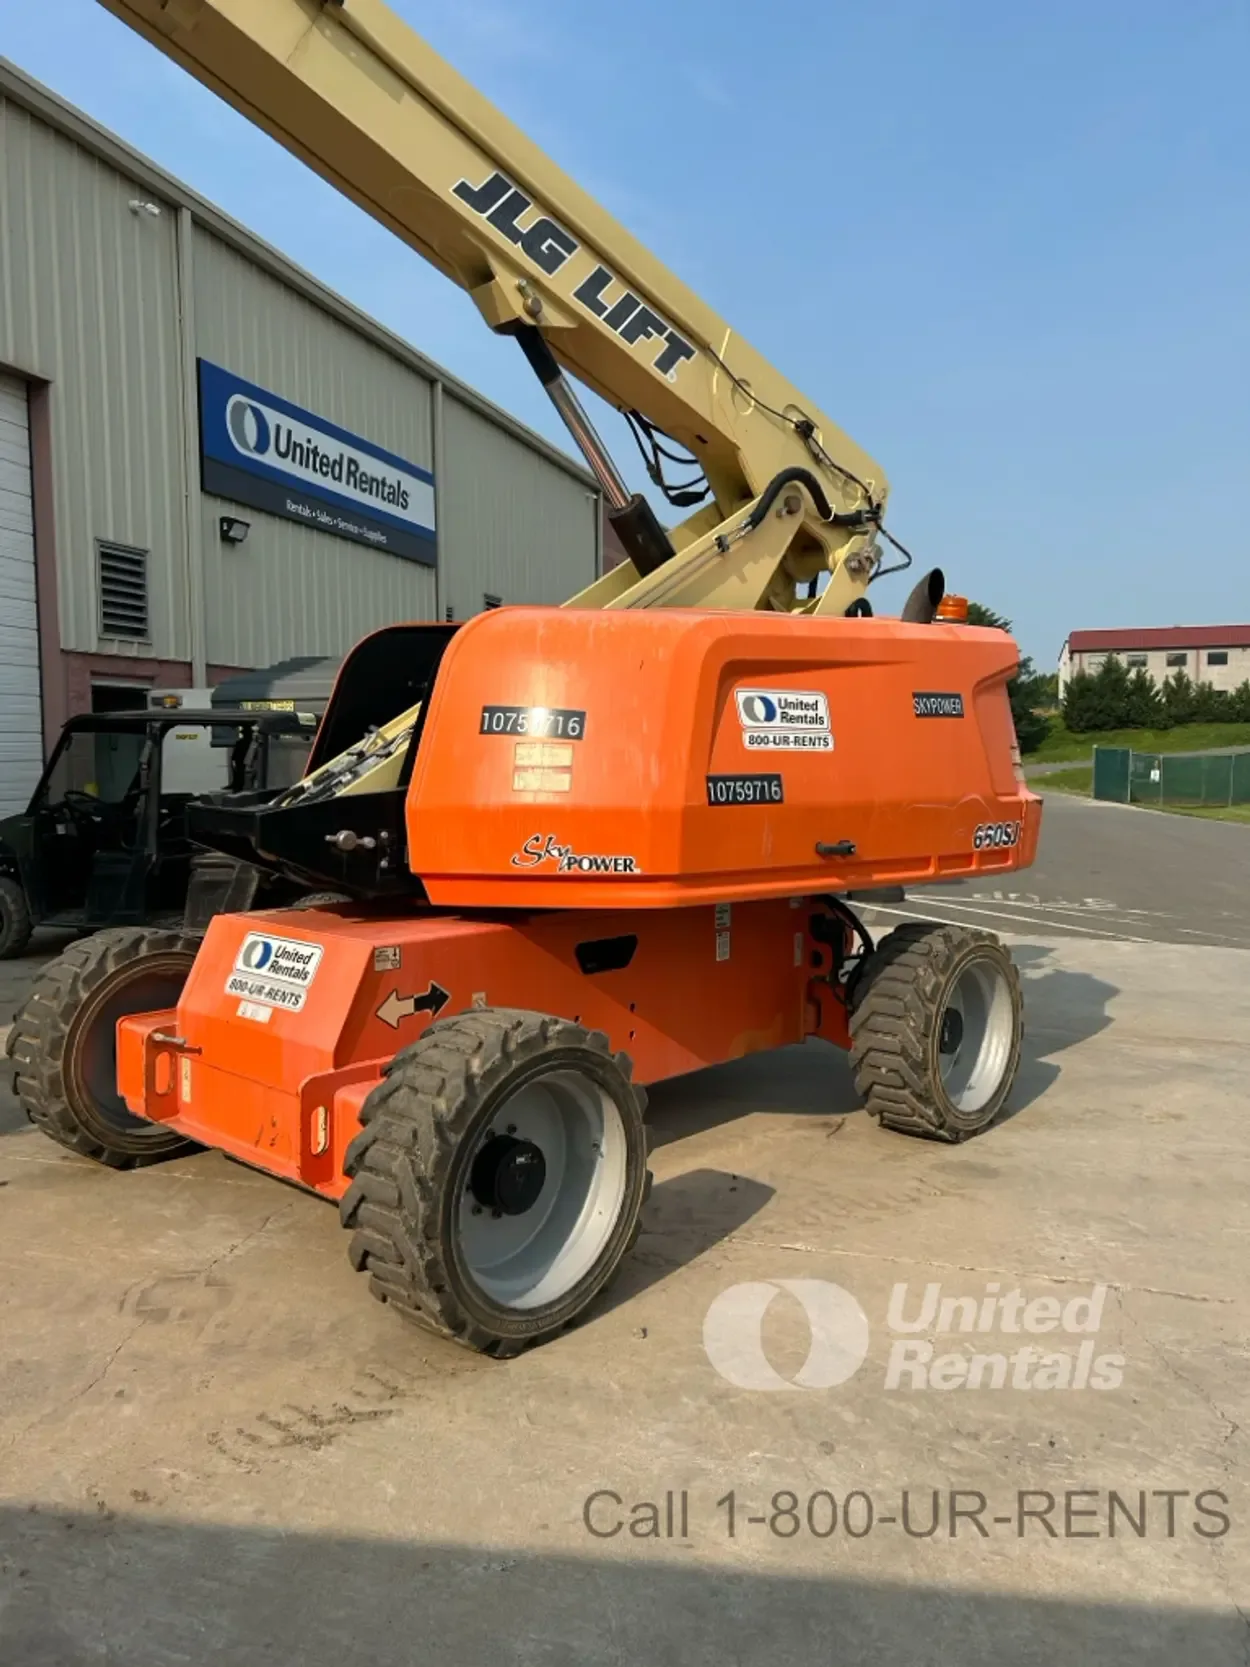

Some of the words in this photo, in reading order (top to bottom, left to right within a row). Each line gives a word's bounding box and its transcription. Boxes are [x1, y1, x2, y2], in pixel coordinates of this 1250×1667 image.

[450, 171, 580, 277] JLG
[573, 264, 697, 376] LIFT
[274, 424, 344, 482] United
[346, 457, 410, 511] Rentals
[777, 698, 819, 712] United
[912, 697, 962, 715] SKYPOWER
[482, 712, 581, 737] 1075716
[780, 711, 825, 726] Rentals
[748, 734, 830, 748] 800-UR-RENTS
[707, 780, 782, 802] 10759716
[273, 945, 313, 965] United
[268, 960, 310, 981] Rentals
[229, 978, 302, 1007] 800-UR-RENTS
